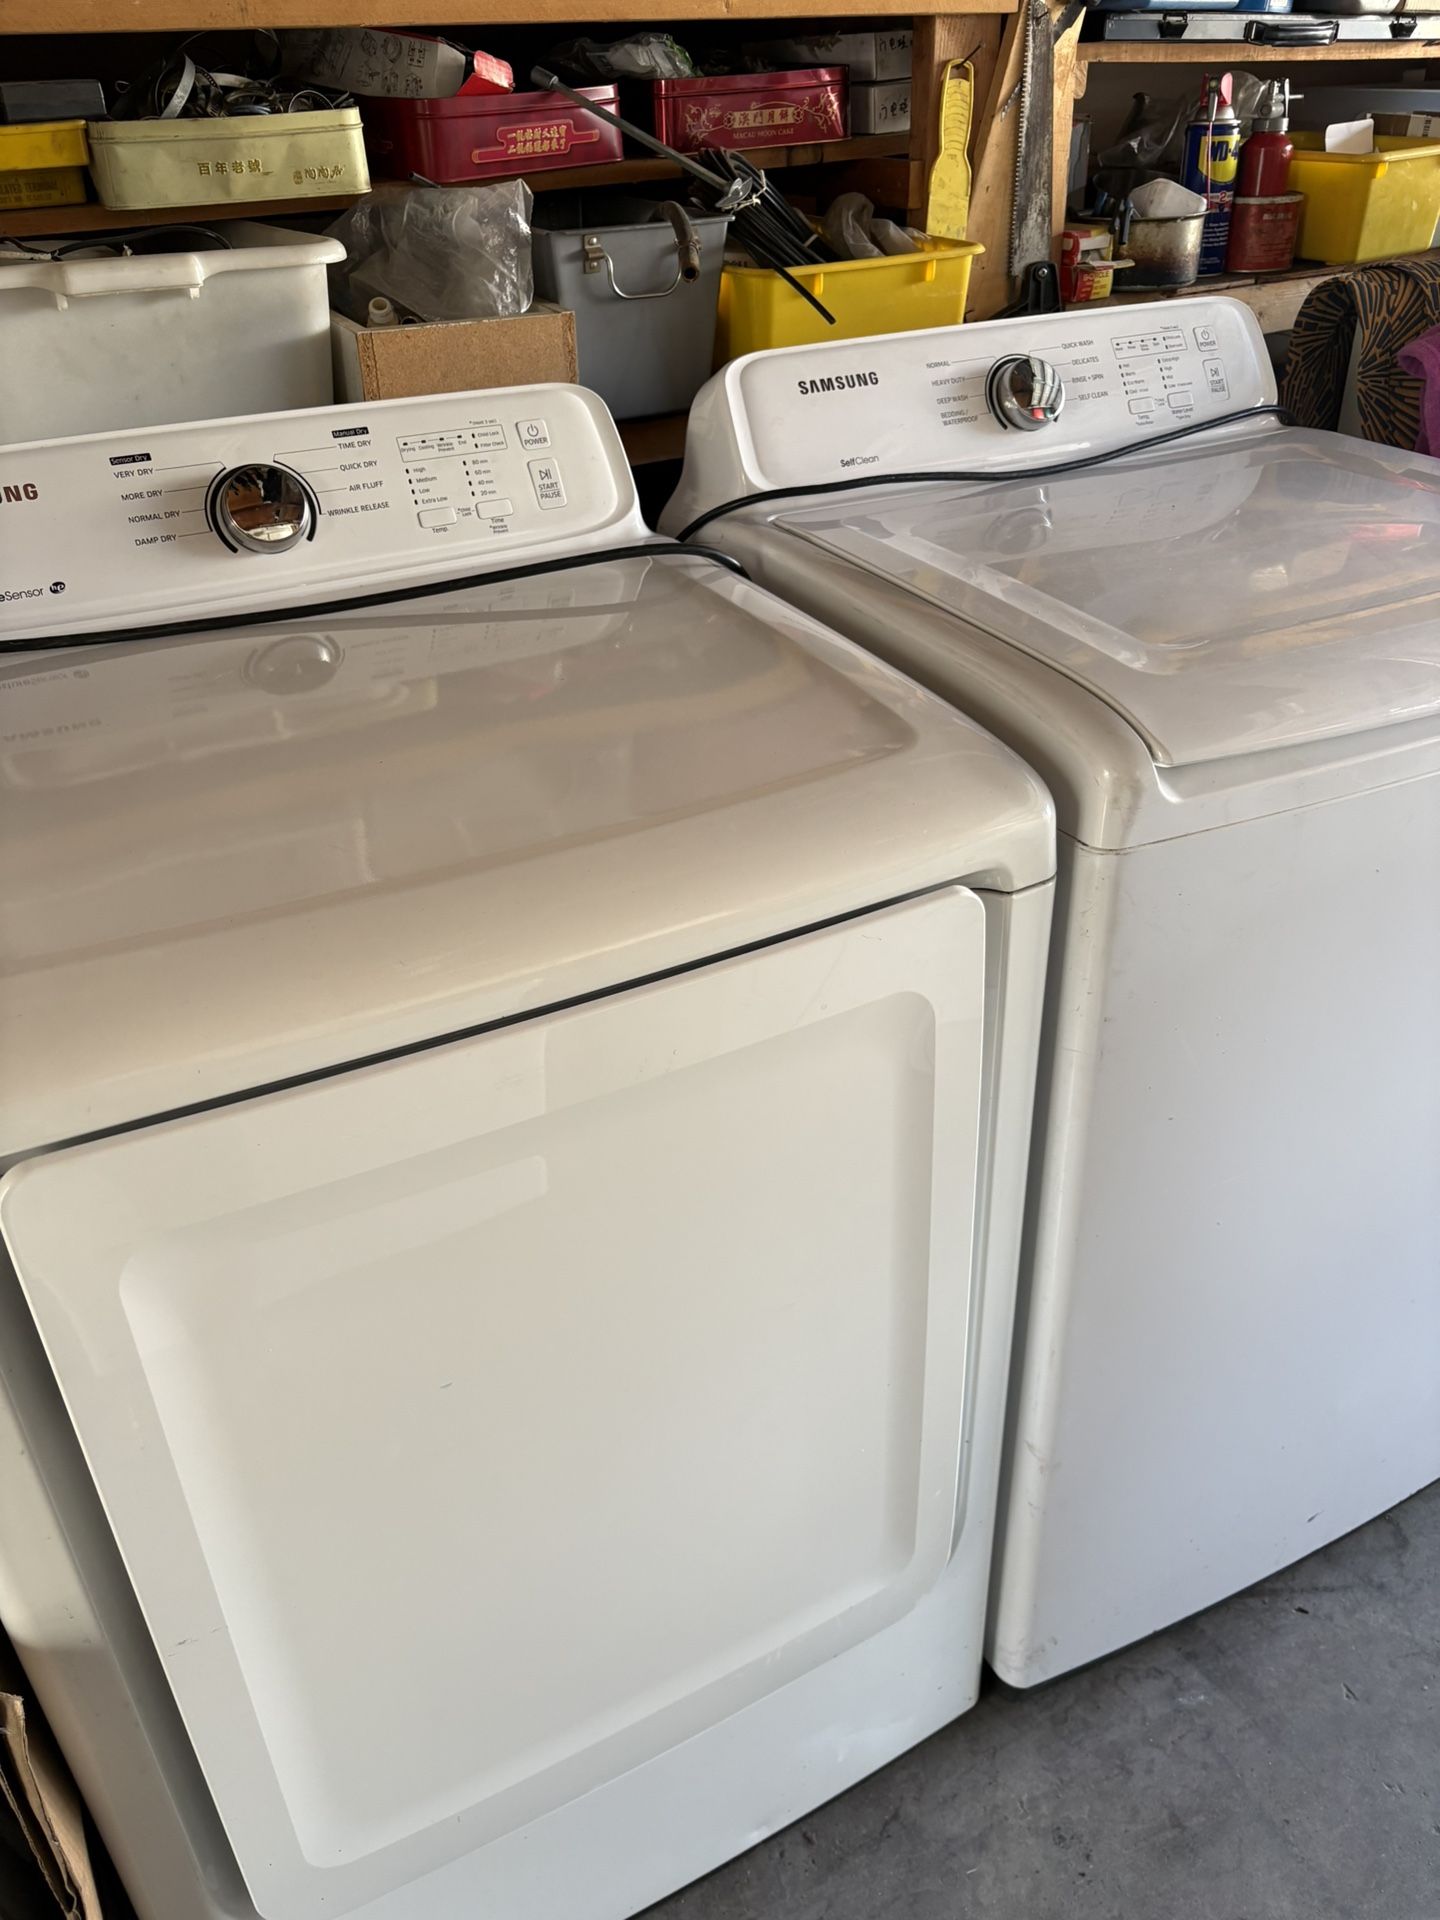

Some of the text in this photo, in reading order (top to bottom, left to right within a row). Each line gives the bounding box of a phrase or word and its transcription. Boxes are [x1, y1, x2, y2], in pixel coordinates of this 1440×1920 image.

[198, 158, 262, 176] 百年老號
[1062, 339, 1094, 349] QUICK WASH
[926, 361, 950, 369] NORMAL
[1072, 356, 1100, 366] DELICATES
[798, 372, 879, 395] SAMSUNG
[931, 376, 966, 386] HEAVY DUTY
[1072, 376, 1086, 384] RINSE
[937, 394, 968, 404] DEEP WASH
[356, 428, 368, 436] Dry
[338, 442, 356, 450] TIME
[524, 436, 548, 446] POWER
[111, 454, 148, 465] Sensor Dry
[840, 454, 880, 468] SelfClean
[340, 460, 378, 472] QUICK DRY
[114, 468, 154, 478] VERY DRY
[349, 480, 384, 492] AIR FLUFF
[538, 482, 559, 490] START
[121, 490, 163, 501] MORE DRY
[540, 491, 561, 500] PAUSE
[327, 502, 390, 517] WRINKLE RELEASE
[128, 510, 180, 524] NORMAL DRY
[134, 534, 177, 546] DAMP DRY
